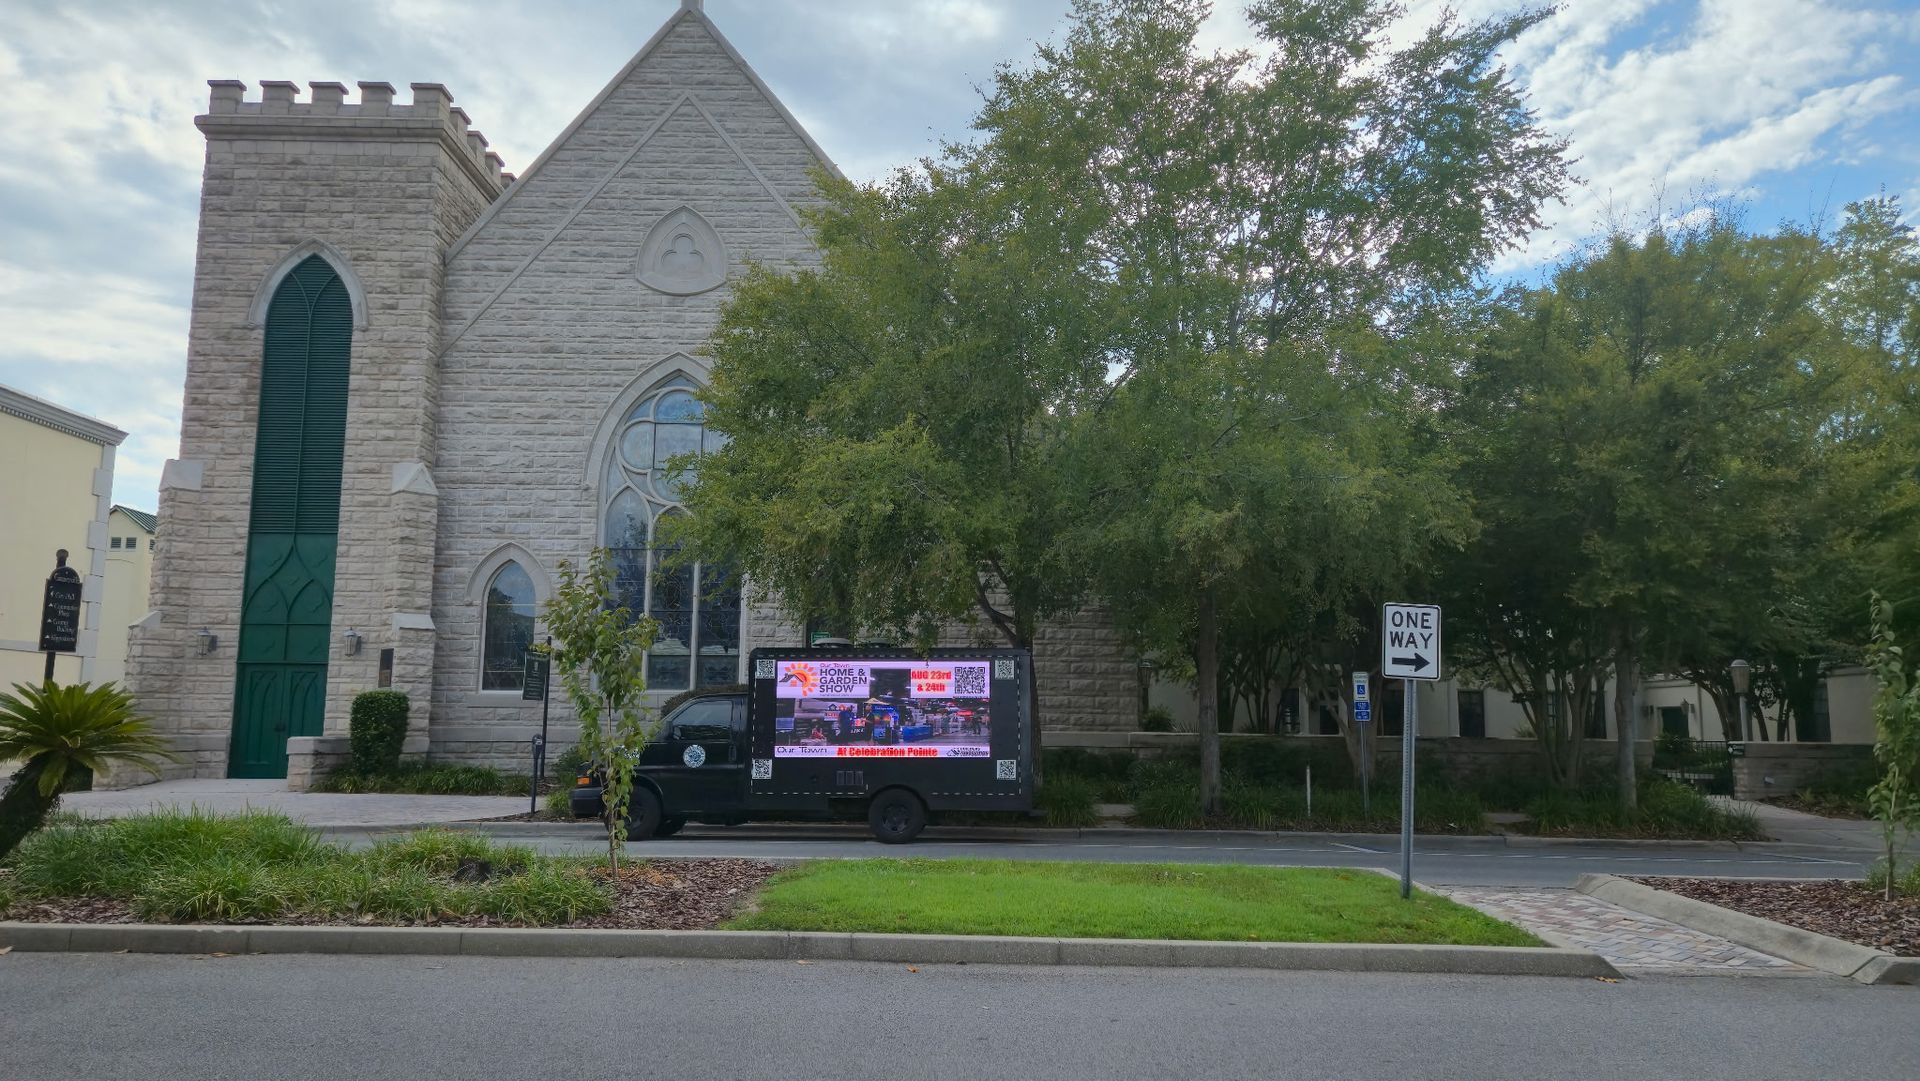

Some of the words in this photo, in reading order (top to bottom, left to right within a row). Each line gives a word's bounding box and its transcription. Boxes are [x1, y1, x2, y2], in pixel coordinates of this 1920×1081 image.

[1391, 611, 1432, 629] ONE
[1390, 631, 1433, 649] WAY
[820, 668, 854, 676] HOME
[857, 668, 866, 676] &
[911, 671, 928, 680] AUG
[930, 671, 952, 680] 23rd
[819, 677, 868, 685] GARDEN
[819, 685, 855, 693] SHOW
[917, 683, 924, 692] &
[925, 683, 945, 692] 24th
[837, 747, 847, 756] At
[849, 747, 905, 756] Celebration
[907, 747, 938, 756] Pointe
